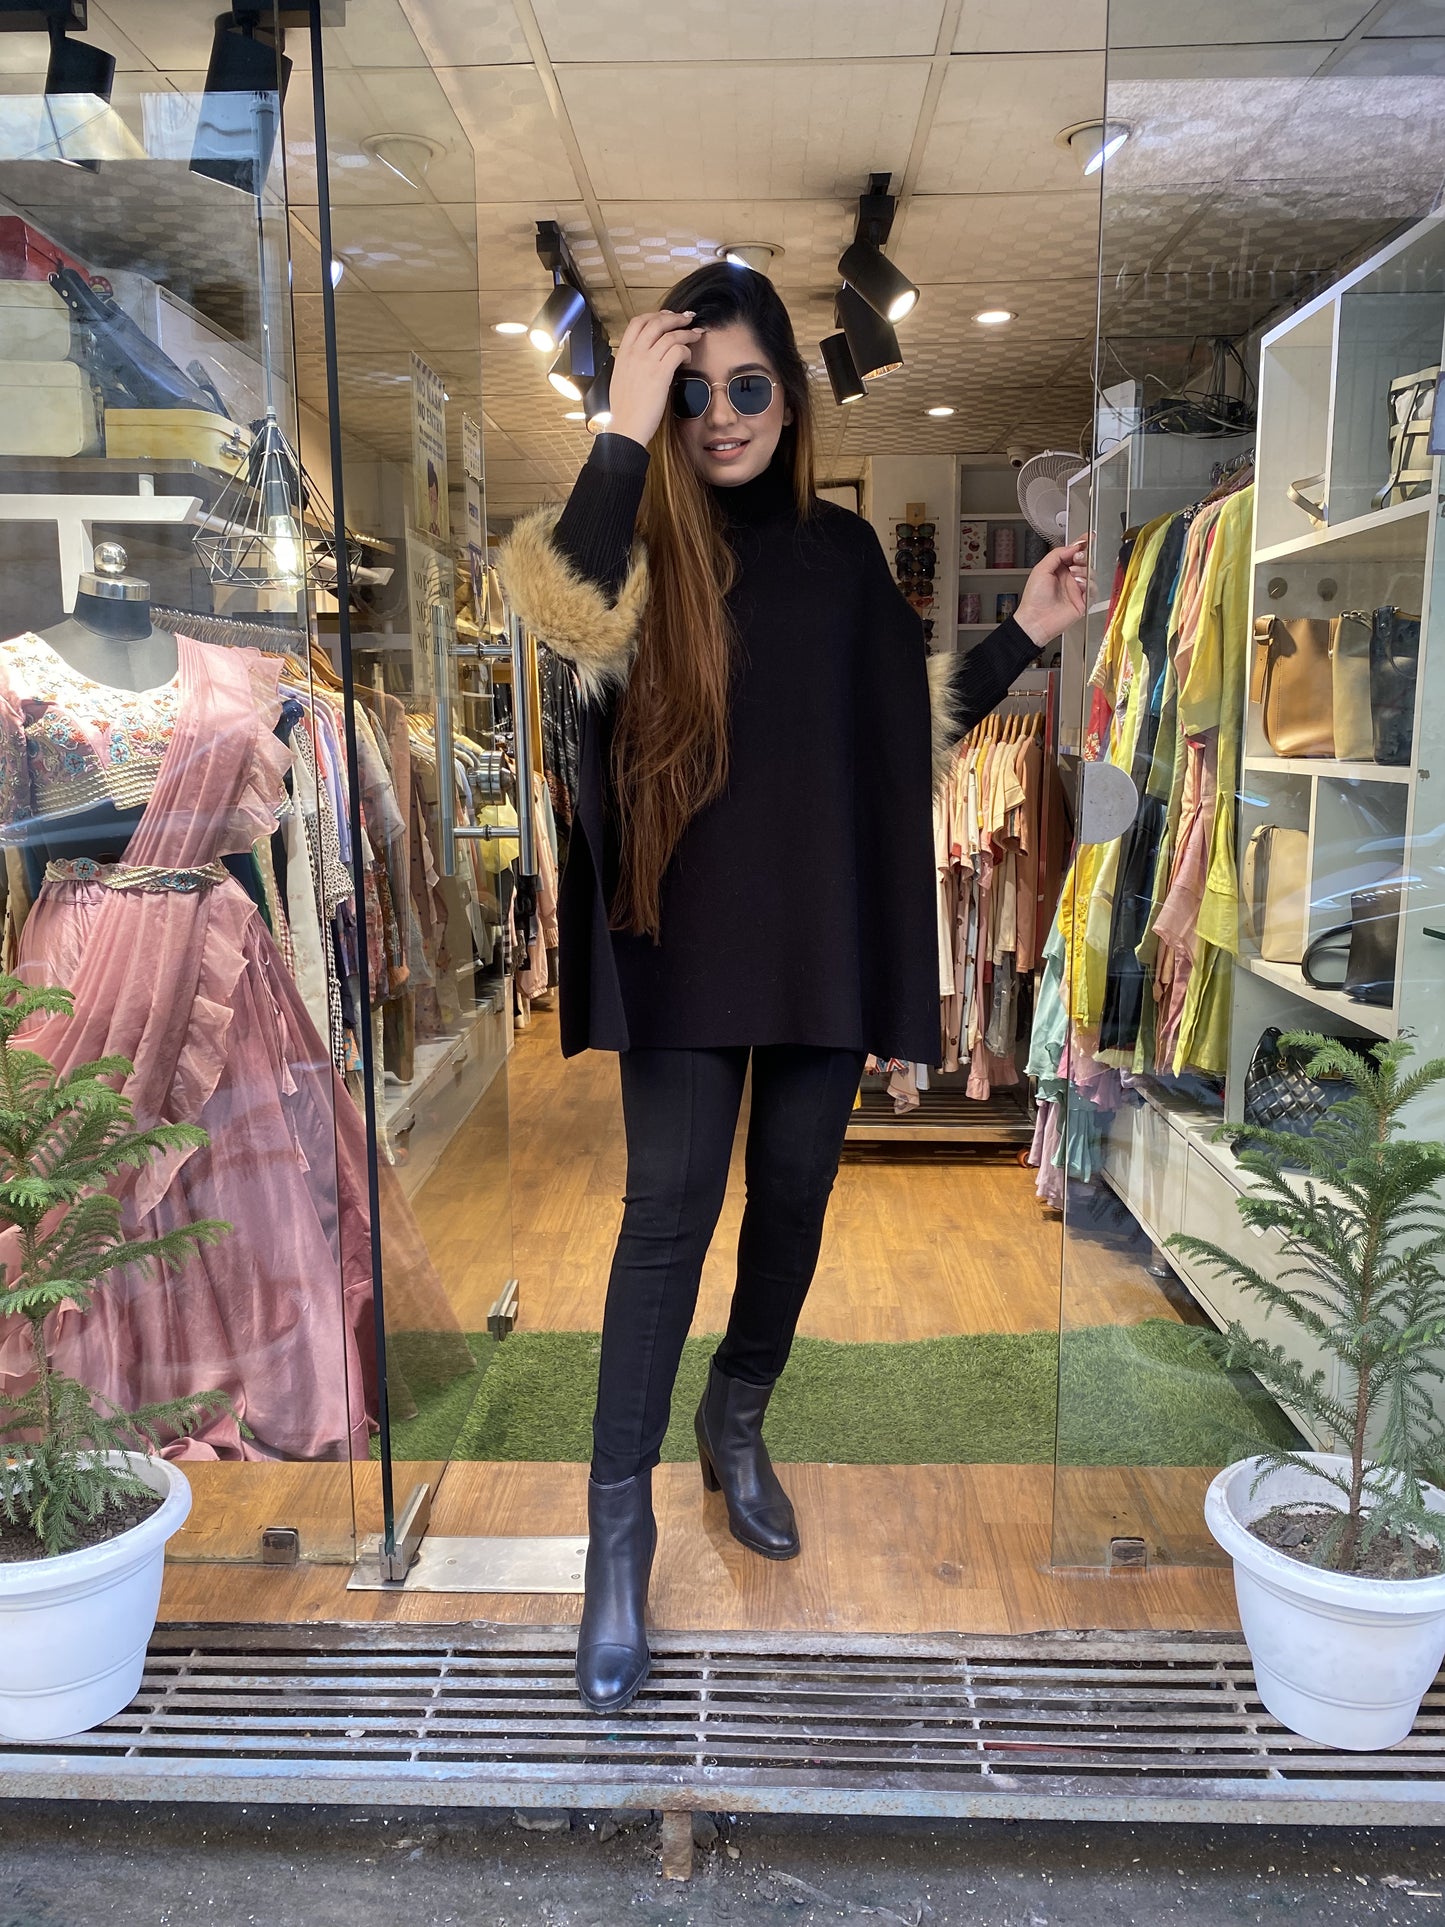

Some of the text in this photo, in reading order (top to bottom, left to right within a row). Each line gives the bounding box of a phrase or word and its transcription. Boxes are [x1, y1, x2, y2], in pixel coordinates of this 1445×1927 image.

[416, 375, 425, 398] NO
[417, 400, 425, 421] NO
[427, 407, 442, 436] ENTRY
